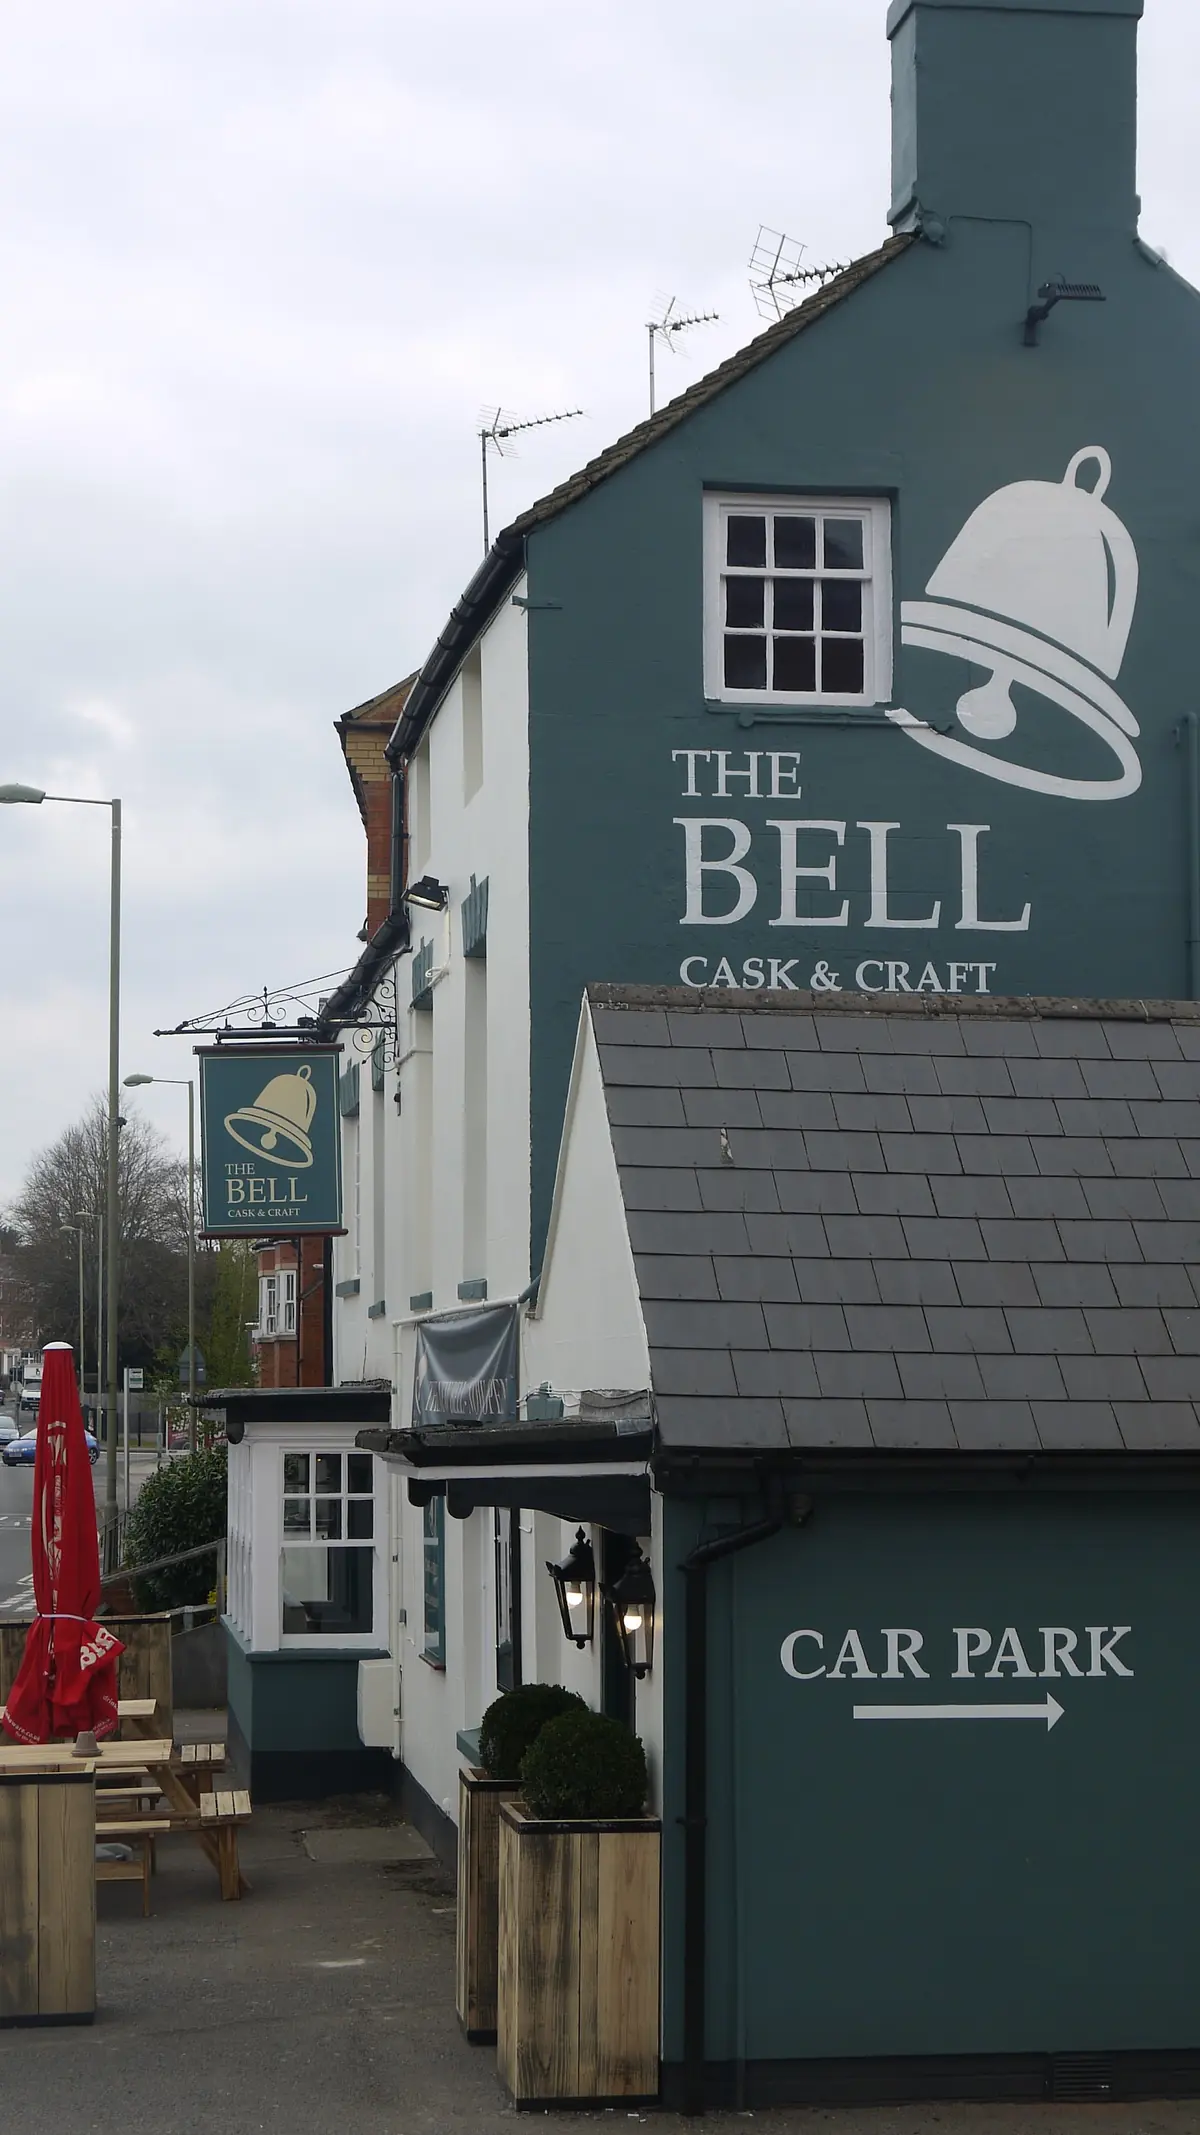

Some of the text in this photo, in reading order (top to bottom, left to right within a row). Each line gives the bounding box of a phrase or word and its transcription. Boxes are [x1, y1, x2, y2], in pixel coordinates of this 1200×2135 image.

[671, 749, 802, 799] THE
[672, 817, 1032, 932] BELL
[679, 955, 997, 993] CASK & CRAFT
[224, 1163, 256, 1175] THE
[225, 1177, 308, 1204] BELL
[227, 1207, 301, 1218] CASK & CRAFT
[780, 1626, 1135, 1680] CAR PARK
